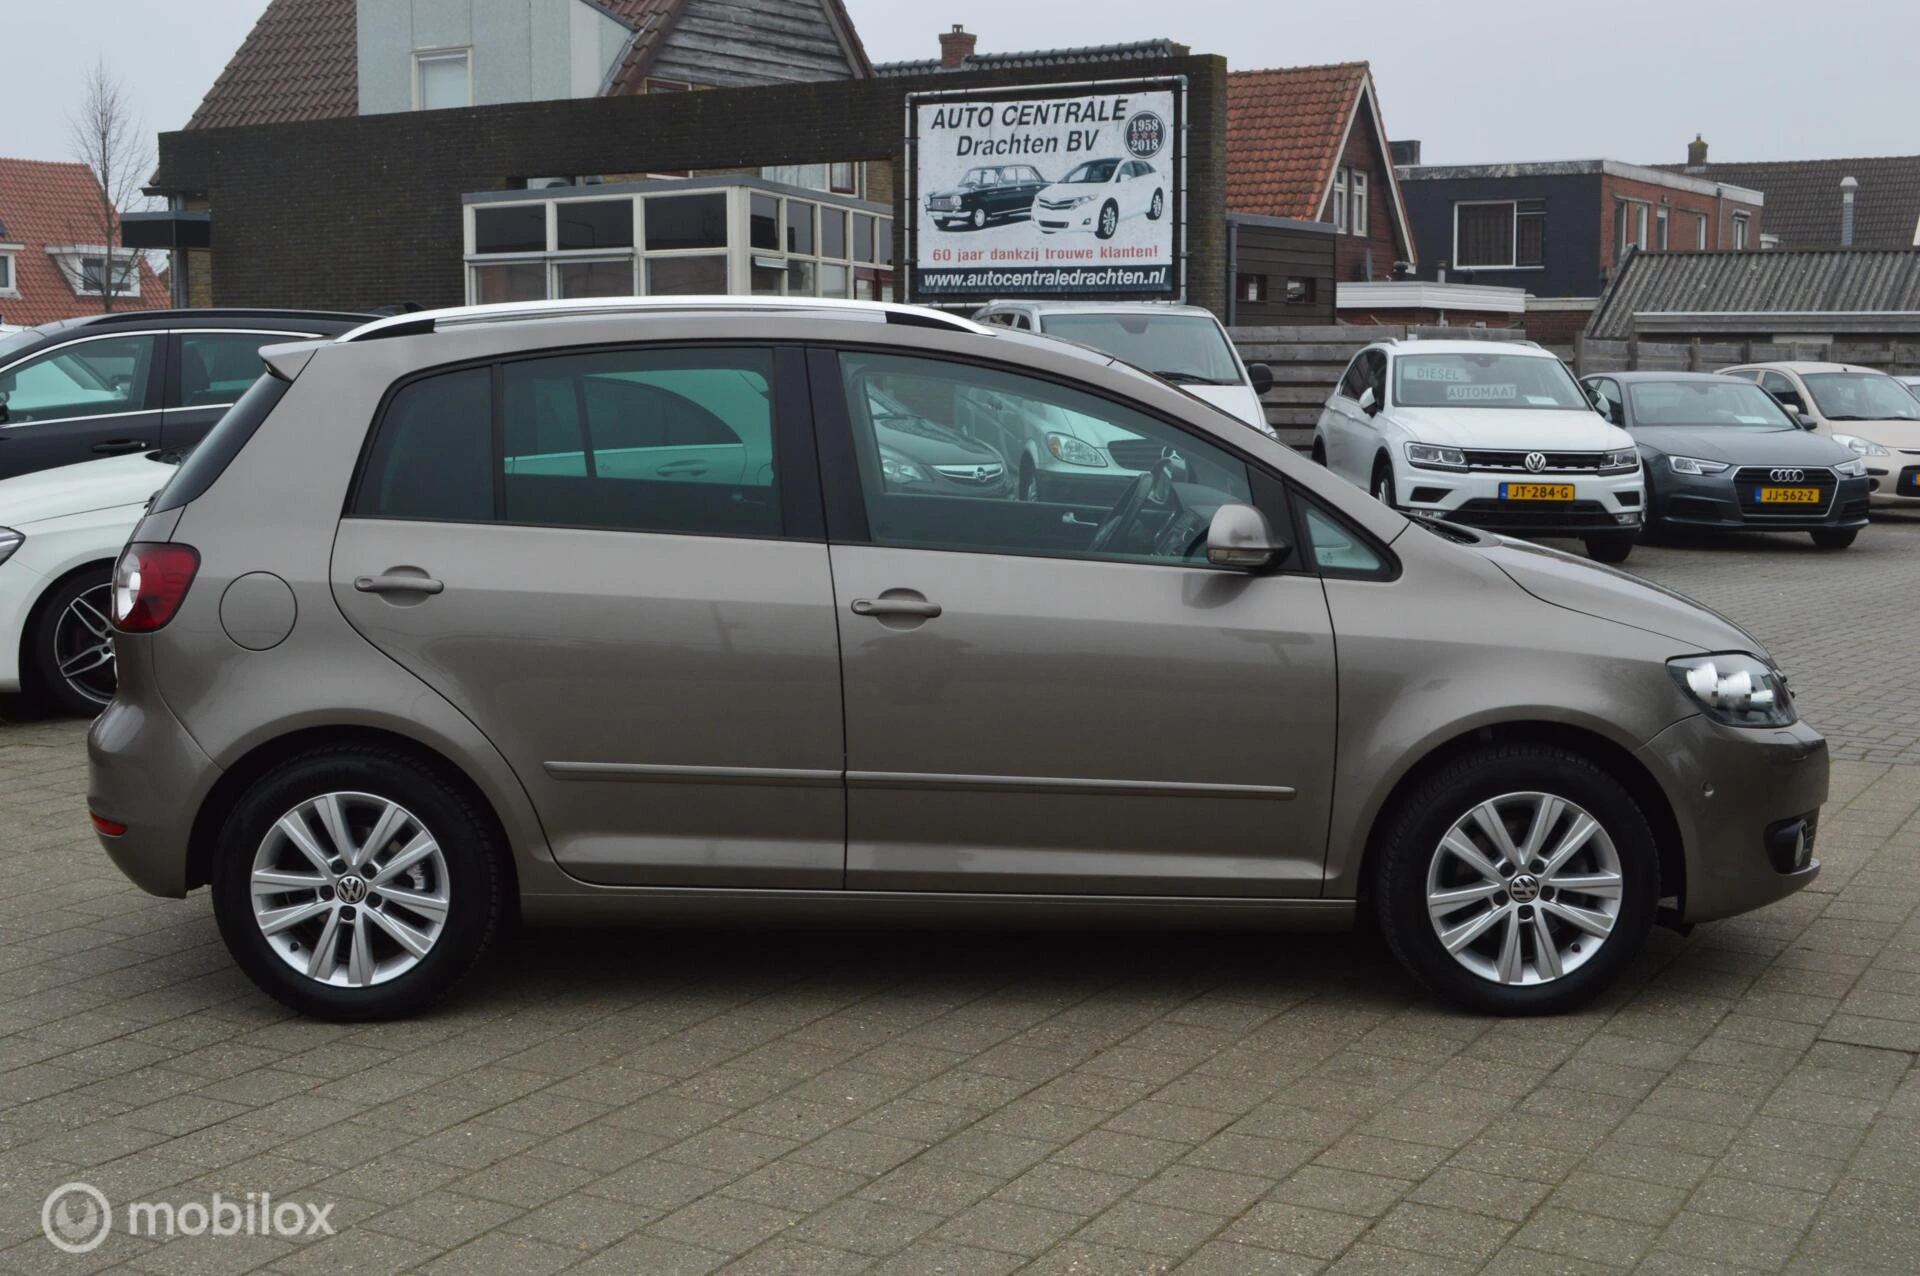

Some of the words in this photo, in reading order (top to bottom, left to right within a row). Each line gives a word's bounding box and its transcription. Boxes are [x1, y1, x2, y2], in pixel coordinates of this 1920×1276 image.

[931, 106, 994, 130] AUTO
[1001, 99, 1128, 126] CENTRALE
[1131, 118, 1159, 132] 1958
[956, 131, 1058, 156] Drachten
[1066, 129, 1100, 152] BV
[1131, 138, 1159, 151] 2018
[932, 248, 951, 261] 60
[957, 248, 983, 262] jaar
[990, 246, 1040, 262] dankzij
[1045, 245, 1093, 260] trouwe
[1099, 244, 1159, 258] klanten!
[924, 267, 1166, 287] www.autocentraledrachten.nl
[1417, 367, 1459, 381] DIESEL
[1448, 385, 1516, 398] AUTOMAAT
[1512, 486, 1568, 499] JT-284-G
[1766, 490, 1814, 501] JJ-562-Z
